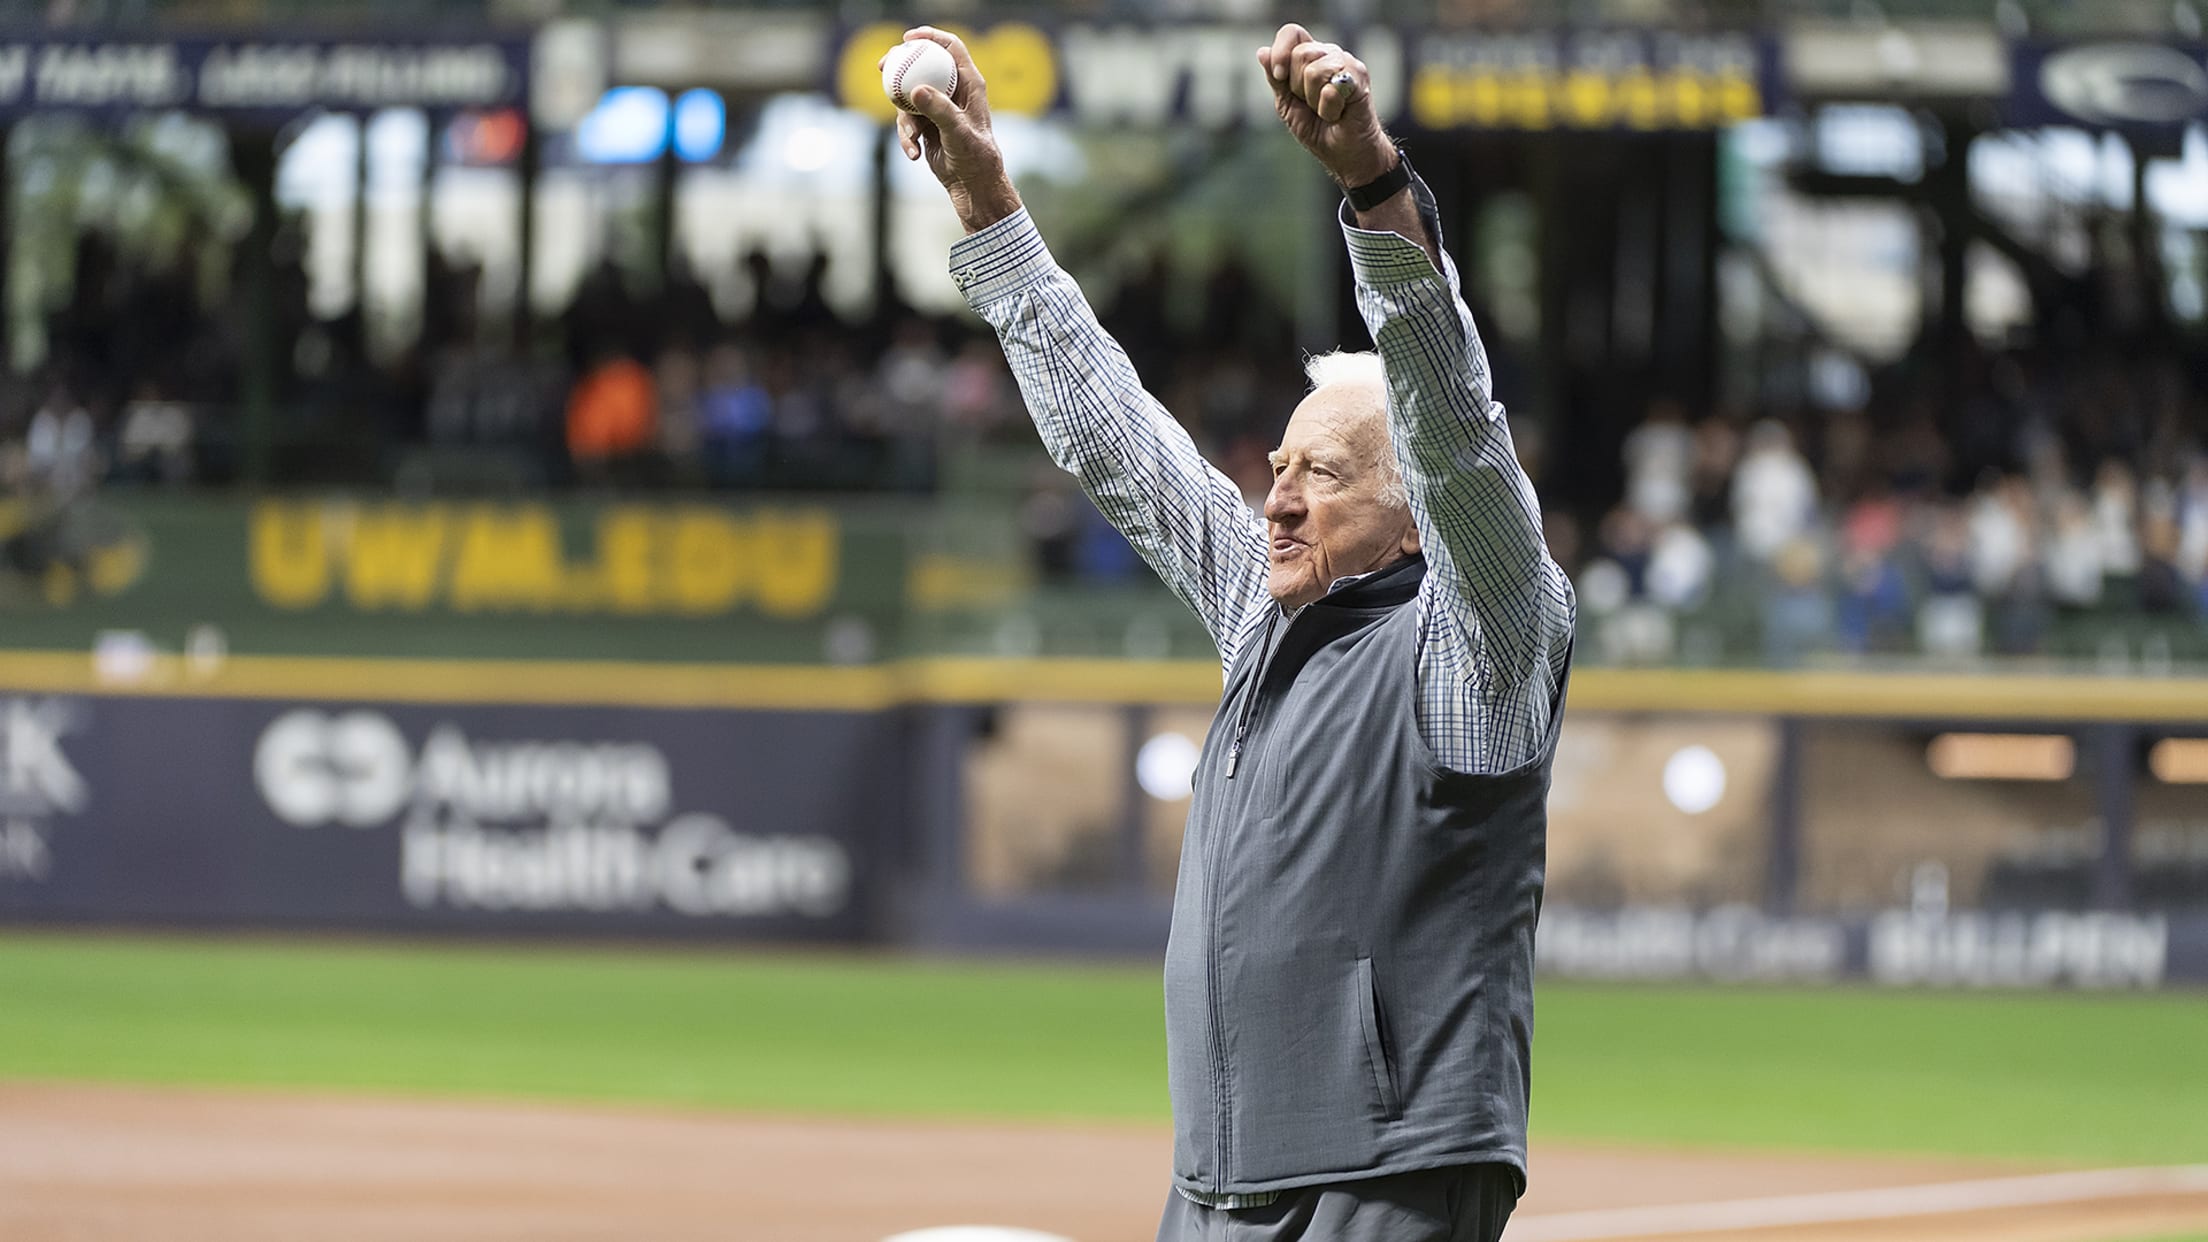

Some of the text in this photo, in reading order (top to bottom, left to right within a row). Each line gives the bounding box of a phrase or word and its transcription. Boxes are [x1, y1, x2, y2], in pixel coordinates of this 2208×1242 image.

[1412, 70, 1758, 128] BREWERS
[252, 503, 838, 612] UWM.EDU
[417, 724, 670, 828] Aurora
[402, 814, 850, 915] Health Care
[1868, 910, 2167, 986] BULLPEN
